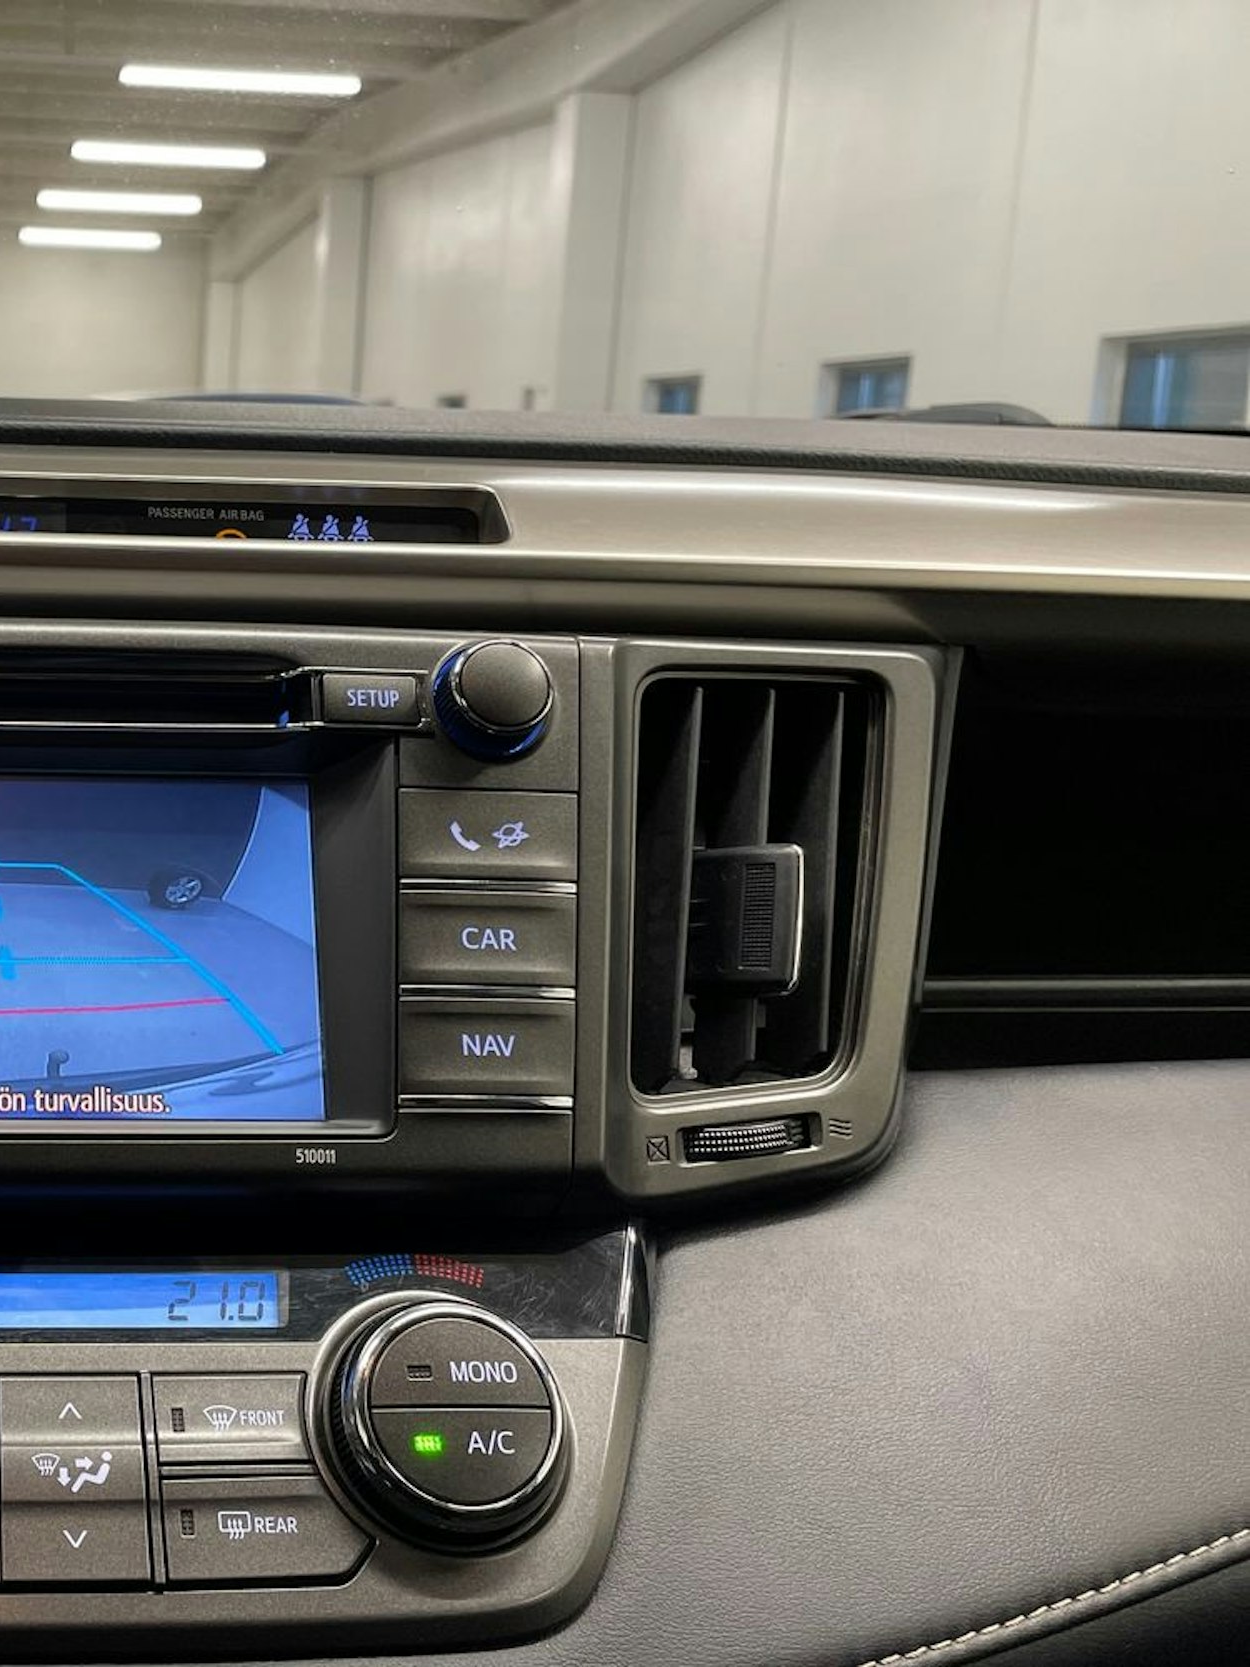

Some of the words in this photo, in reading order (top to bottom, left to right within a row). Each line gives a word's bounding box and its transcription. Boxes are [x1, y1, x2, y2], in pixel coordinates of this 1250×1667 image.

[147, 506, 215, 520] PASSENGER
[347, 688, 400, 709] SETUP
[461, 927, 517, 951] CAR
[461, 1034, 515, 1057] NAV
[34, 1086, 171, 1113] turvallisuus.
[295, 1148, 336, 1165] 510011
[168, 1281, 266, 1321] 21.0
[449, 1361, 518, 1384] MONO
[239, 1409, 285, 1427] FRONT
[467, 1429, 516, 1456] A/C
[253, 1515, 299, 1535] REAR
